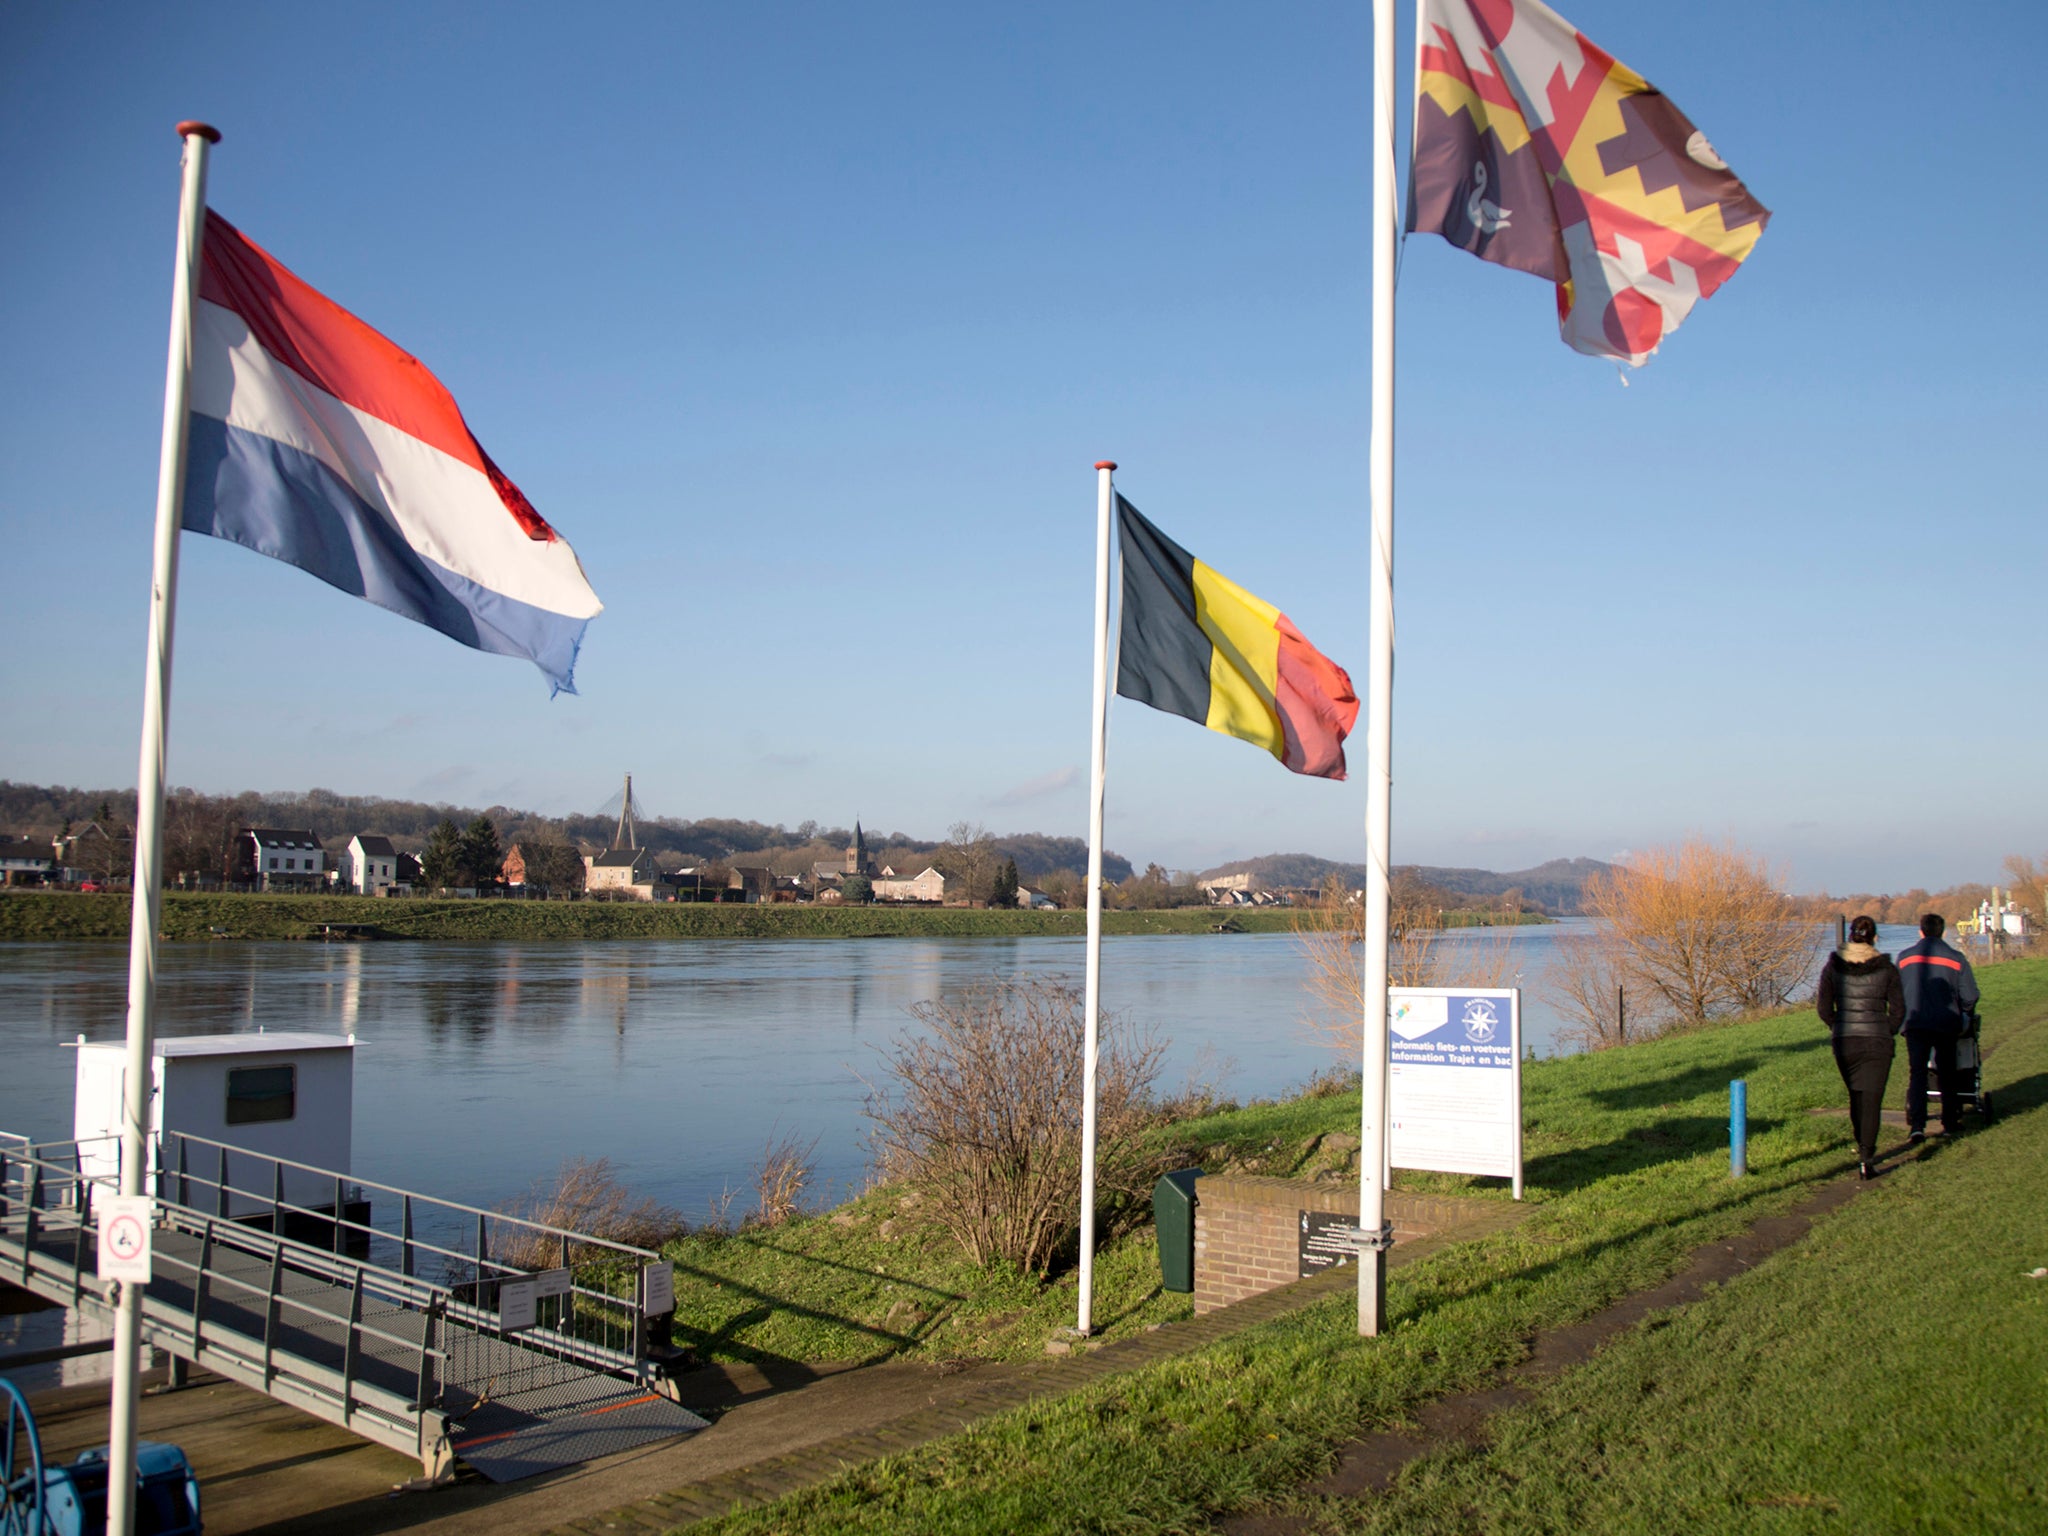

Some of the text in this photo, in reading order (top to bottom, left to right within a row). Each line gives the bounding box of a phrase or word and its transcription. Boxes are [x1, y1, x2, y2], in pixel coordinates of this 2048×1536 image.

[1436, 1042, 1458, 1052] fiets-
[1460, 1044, 1471, 1053] en
[1473, 1044, 1511, 1054] voetveer
[1392, 1051, 1511, 1065] Information Trajet en bac
